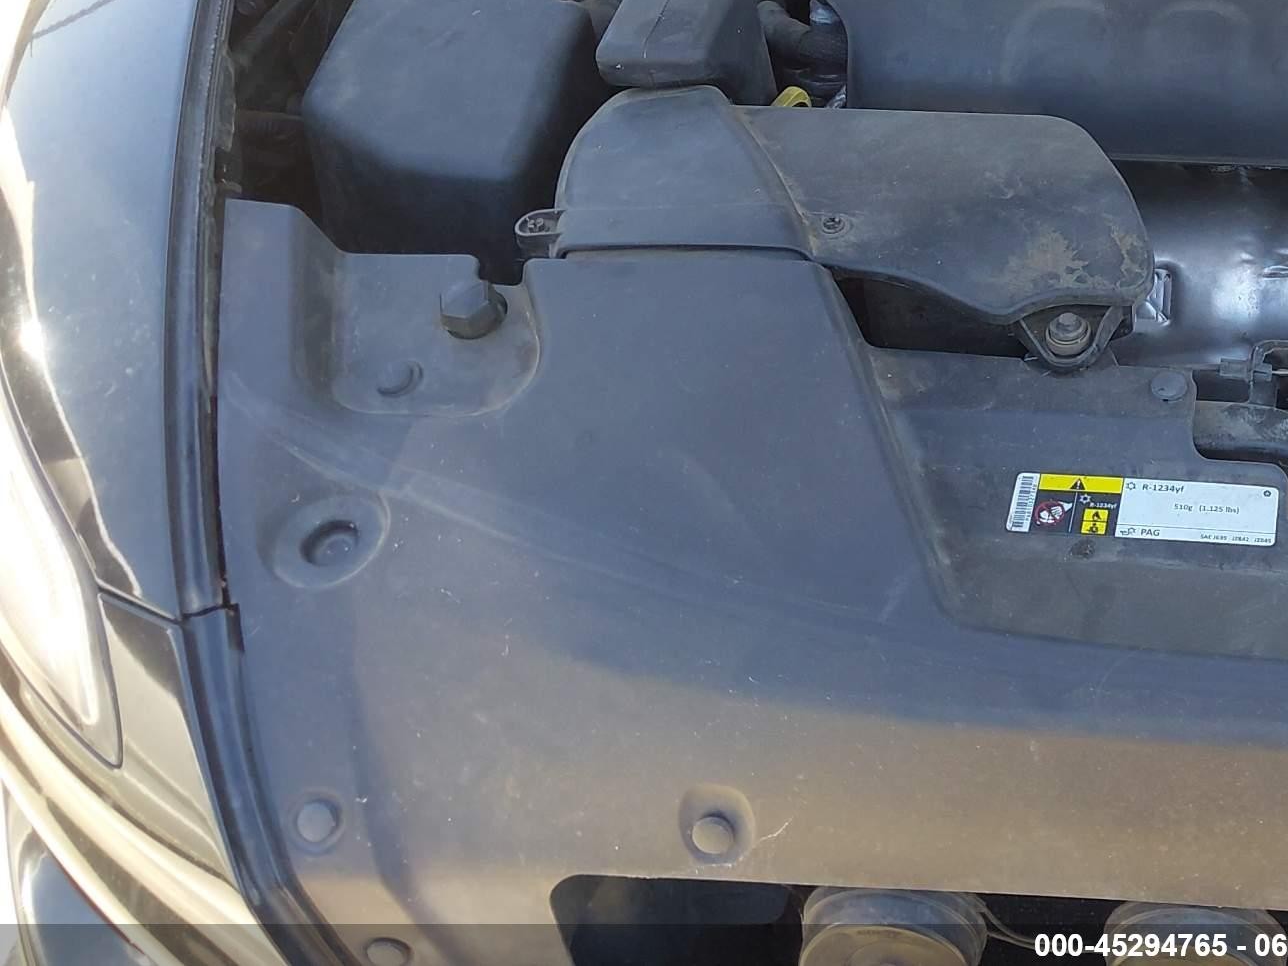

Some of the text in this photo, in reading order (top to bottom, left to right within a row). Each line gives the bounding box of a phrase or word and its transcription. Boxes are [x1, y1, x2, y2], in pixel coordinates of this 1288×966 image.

[1142, 484, 1184, 494] R-1234yf
[1174, 503, 1193, 512] 510g
[1225, 506, 1240, 514] lbs)
[1140, 528, 1160, 537] PAG
